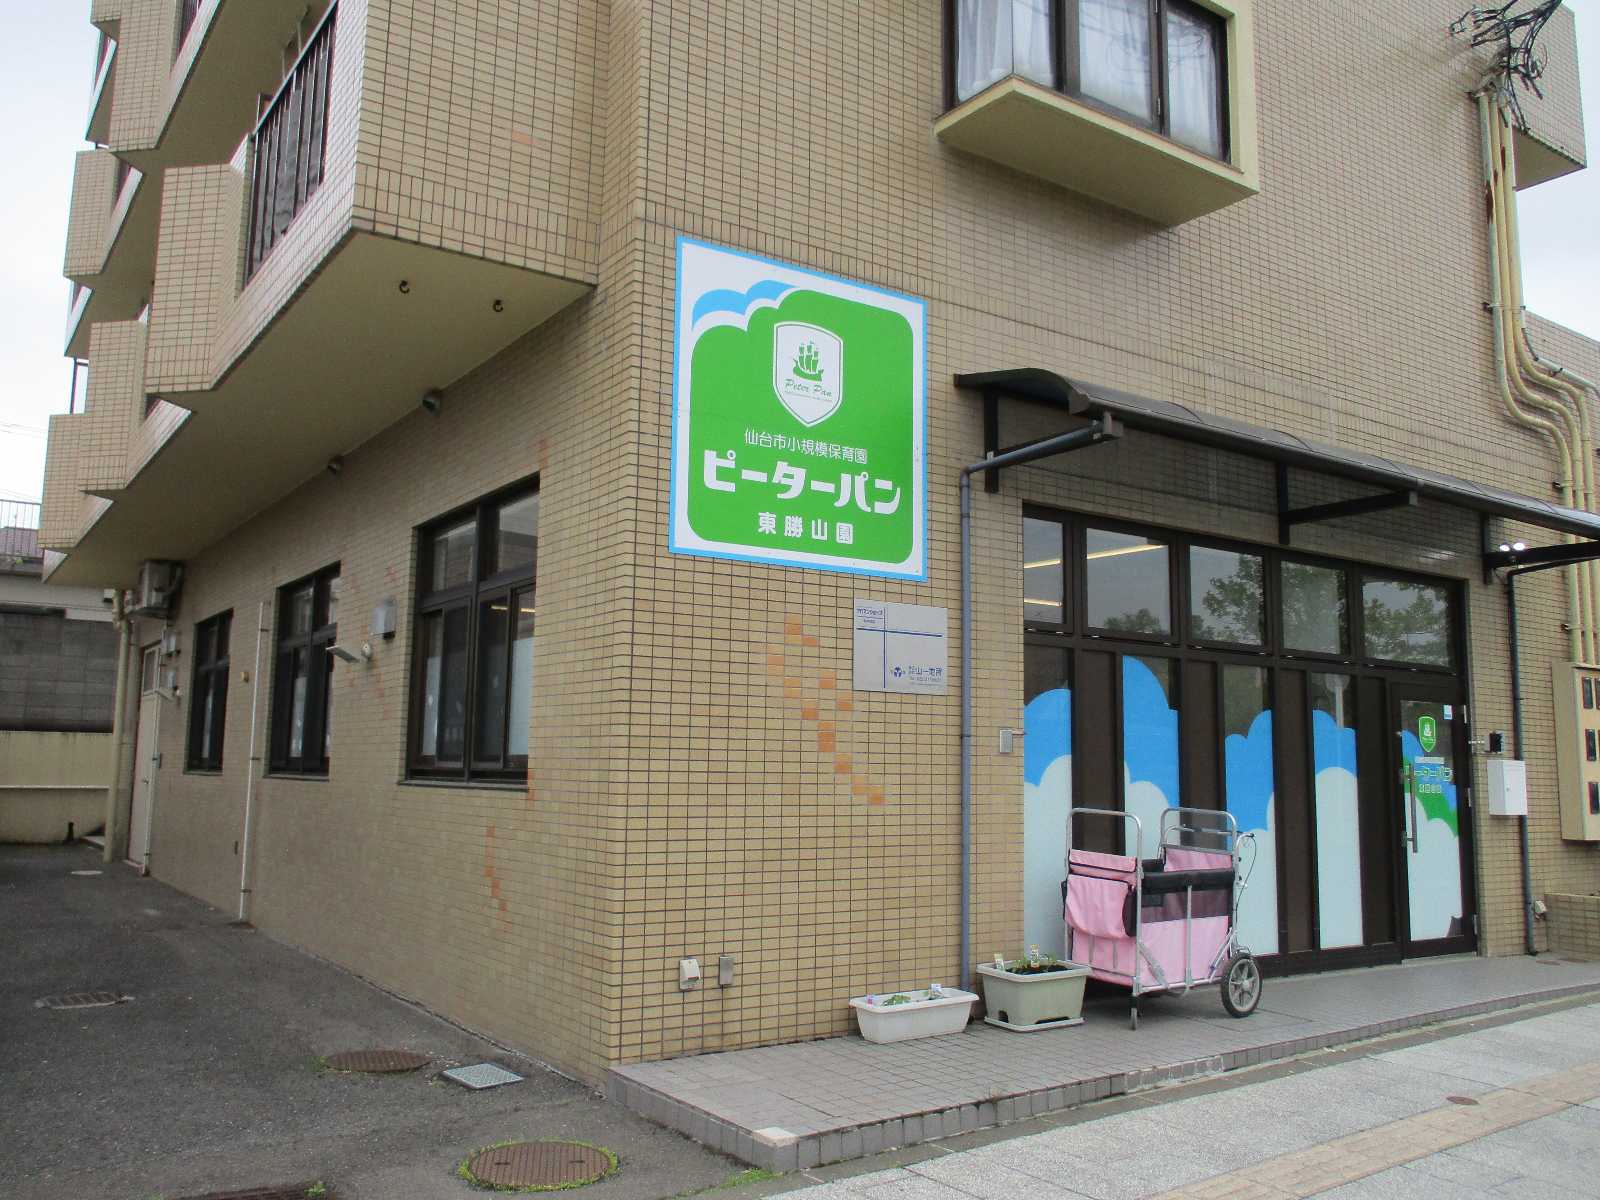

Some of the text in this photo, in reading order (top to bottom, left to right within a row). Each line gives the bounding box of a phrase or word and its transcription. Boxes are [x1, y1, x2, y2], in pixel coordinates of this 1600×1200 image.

[784, 378, 809, 392] Peter
[814, 384, 833, 397] Pan
[744, 427, 868, 465] 仙台市小規模保育園
[703, 449, 901, 515] ピーターパン
[757, 511, 854, 545] 東勝山園
